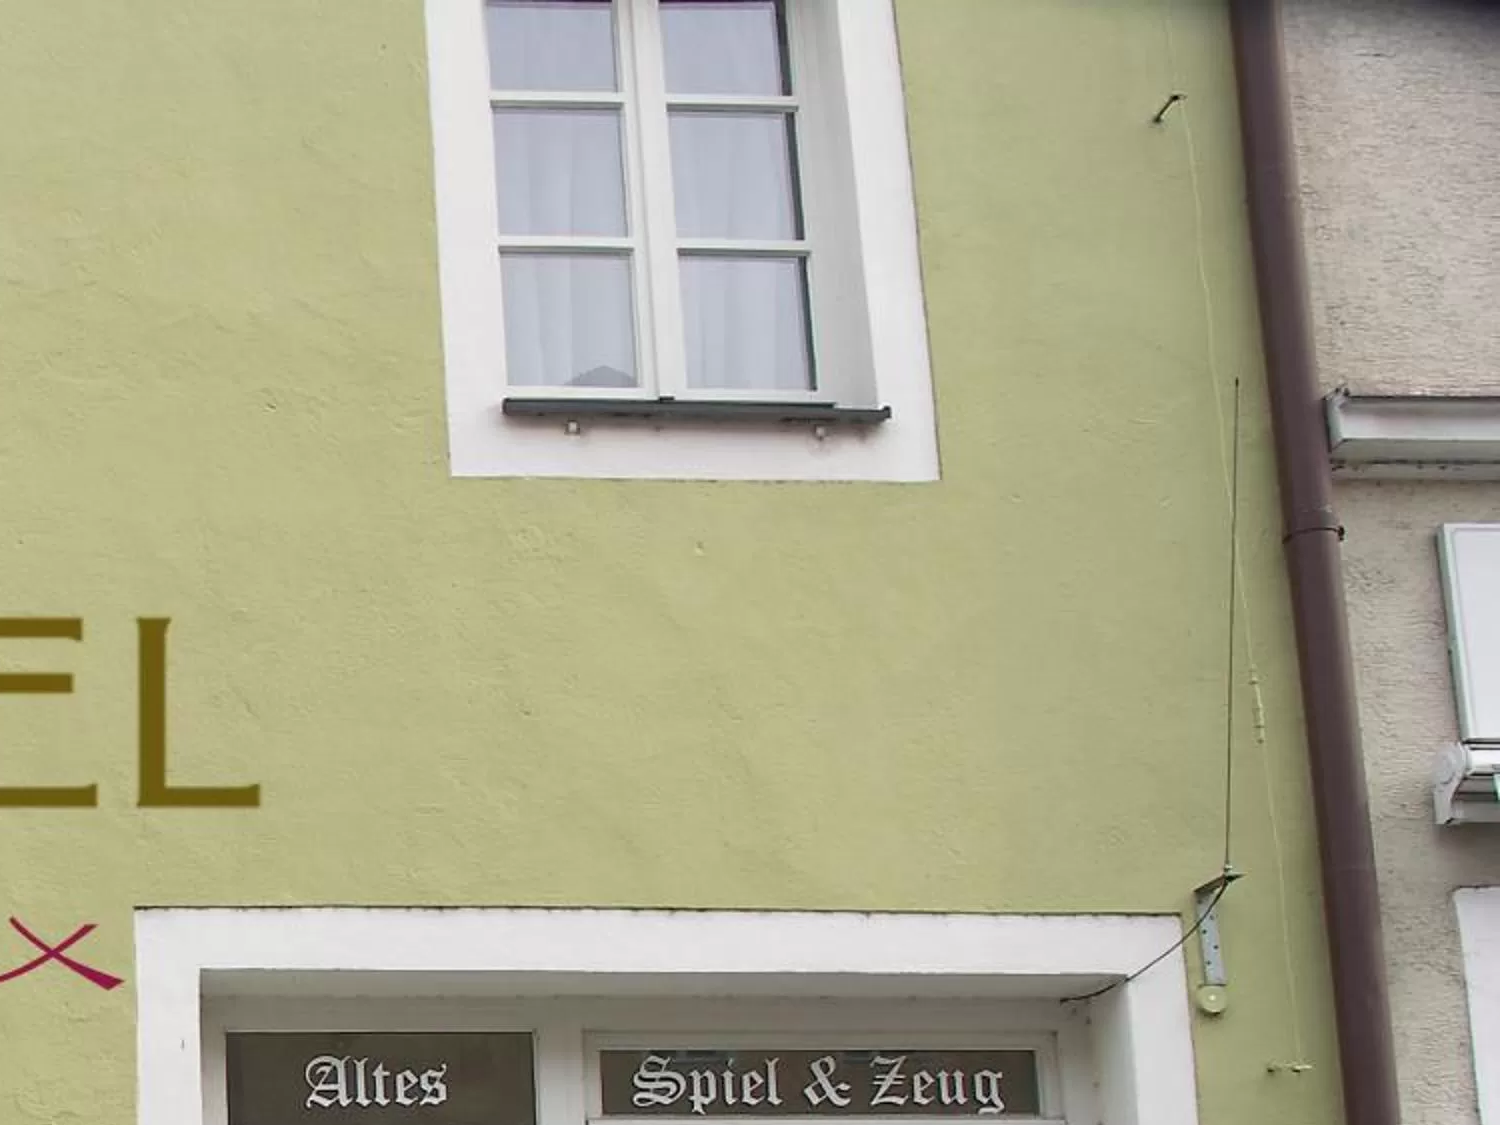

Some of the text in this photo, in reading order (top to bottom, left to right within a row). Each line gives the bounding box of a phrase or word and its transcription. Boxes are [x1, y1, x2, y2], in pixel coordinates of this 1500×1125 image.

[304, 1055, 448, 1110] Altes
[632, 1055, 1006, 1115] Spiel & Zeug
